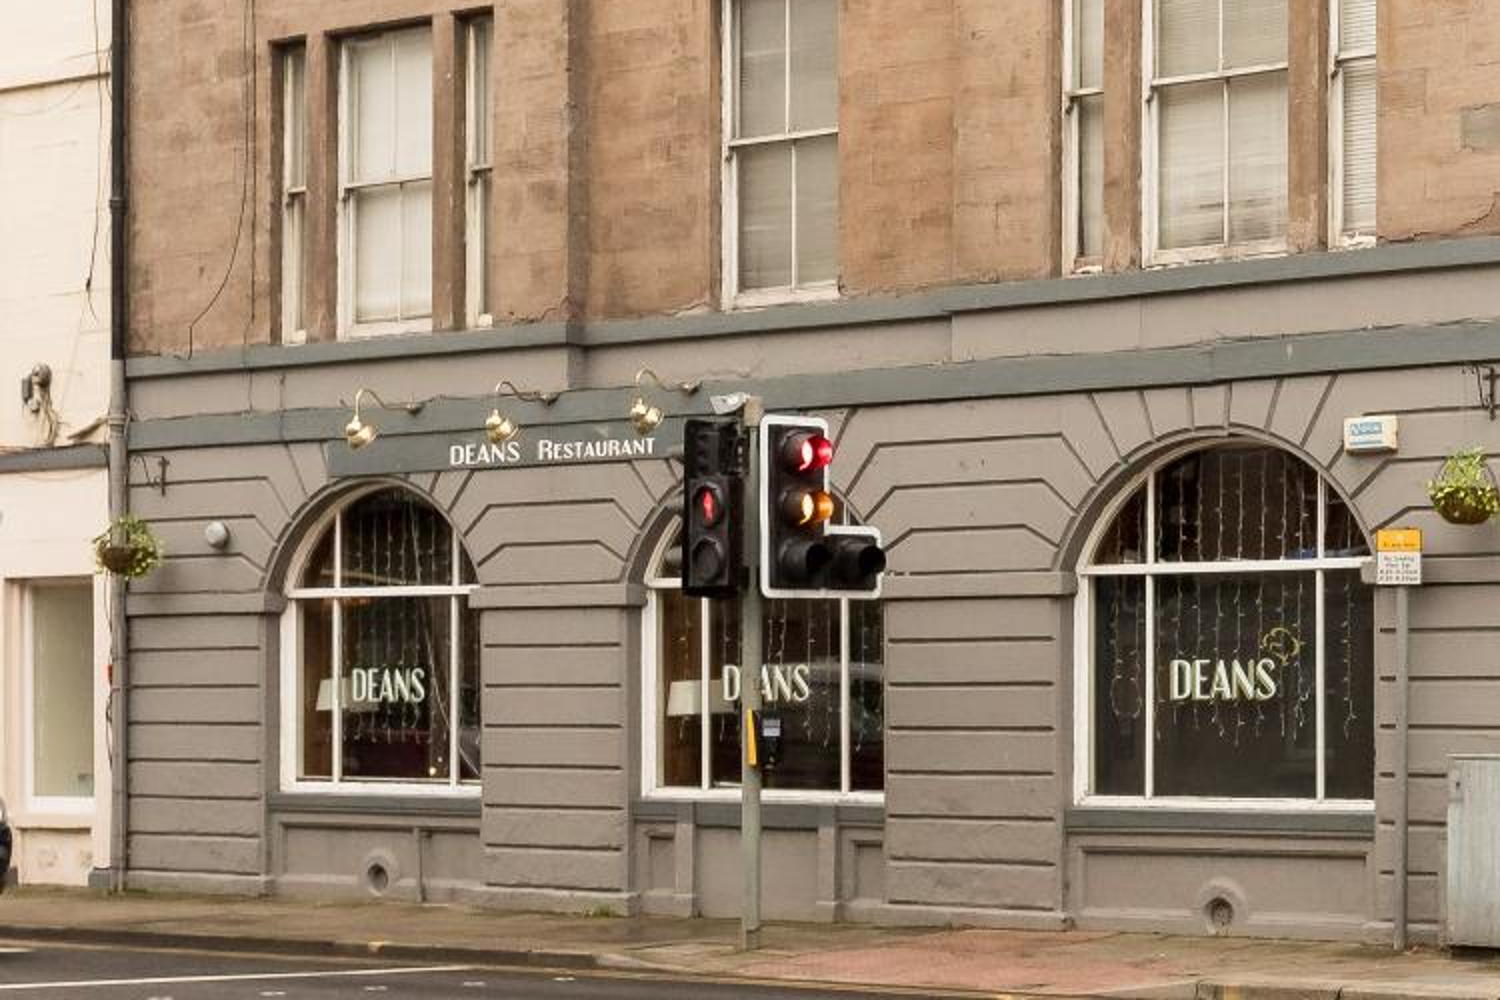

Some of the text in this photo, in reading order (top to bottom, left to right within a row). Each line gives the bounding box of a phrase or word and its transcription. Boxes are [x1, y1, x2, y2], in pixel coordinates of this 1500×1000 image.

[450, 437, 656, 465] DEANS RESTAURANT
[352, 667, 425, 702] DEANS
[722, 664, 810, 702] DANS
[1169, 658, 1276, 701] DEANS
